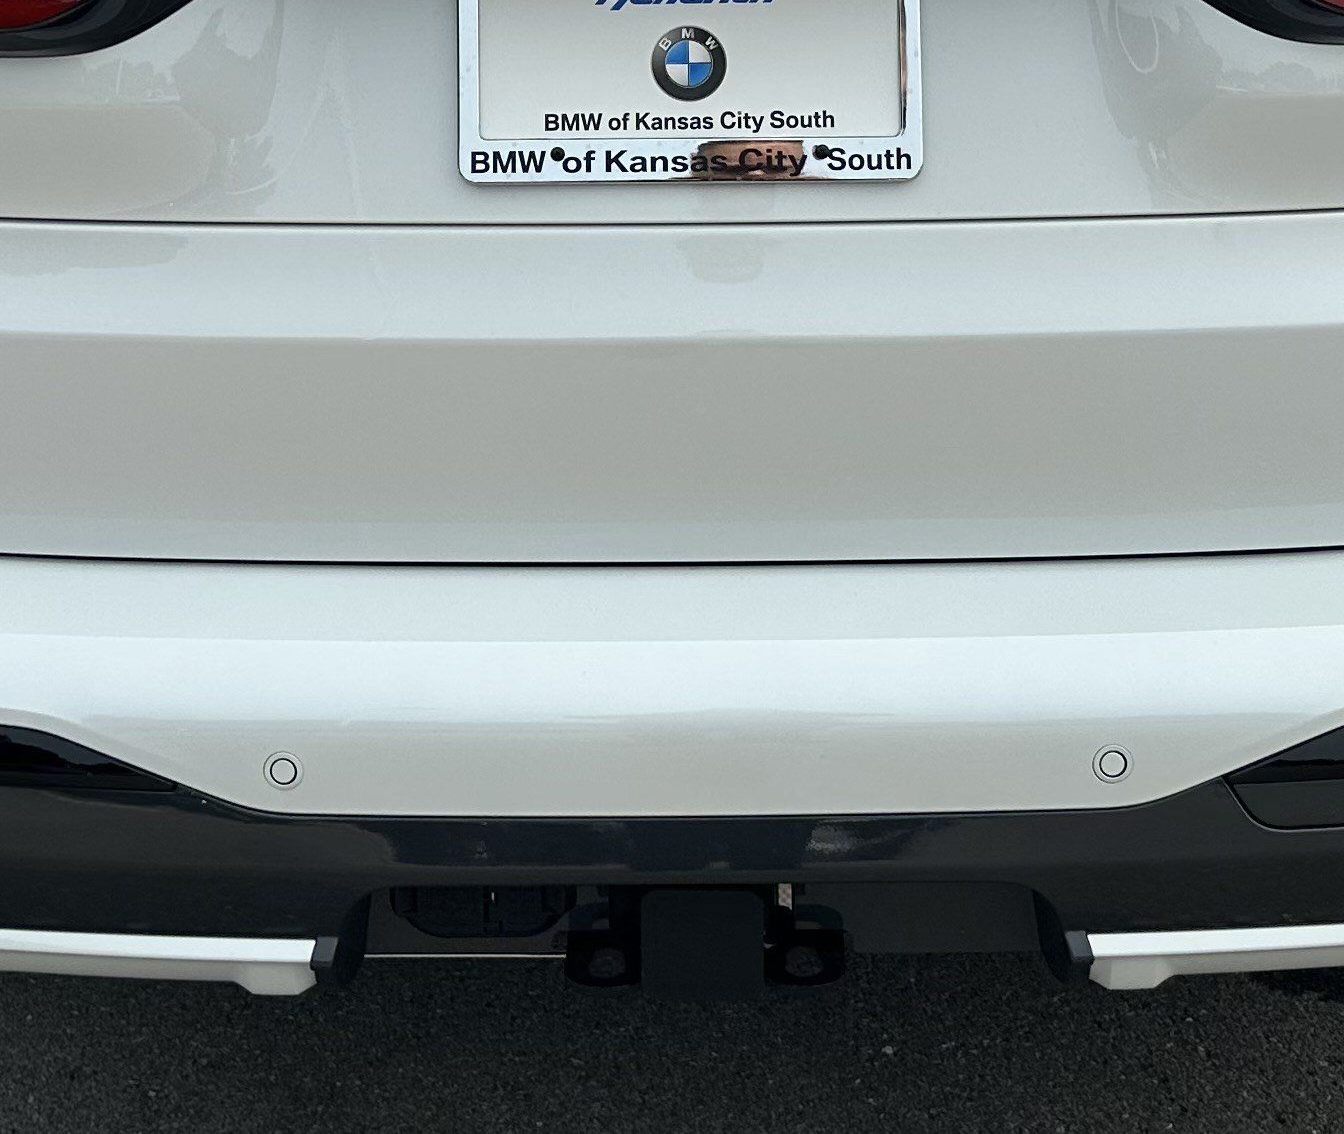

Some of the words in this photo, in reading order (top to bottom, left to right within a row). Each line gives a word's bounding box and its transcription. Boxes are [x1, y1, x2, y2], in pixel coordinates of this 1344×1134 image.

[658, 27, 719, 51] BMW
[544, 113, 603, 132] BMW
[608, 113, 631, 131] of
[635, 112, 714, 131] Kansas
[720, 111, 765, 133] City
[769, 110, 835, 129] South
[470, 150, 547, 174] BMW
[562, 150, 596, 173] of
[605, 149, 728, 174] Kansas
[738, 148, 808, 177] City
[827, 147, 912, 172] South
